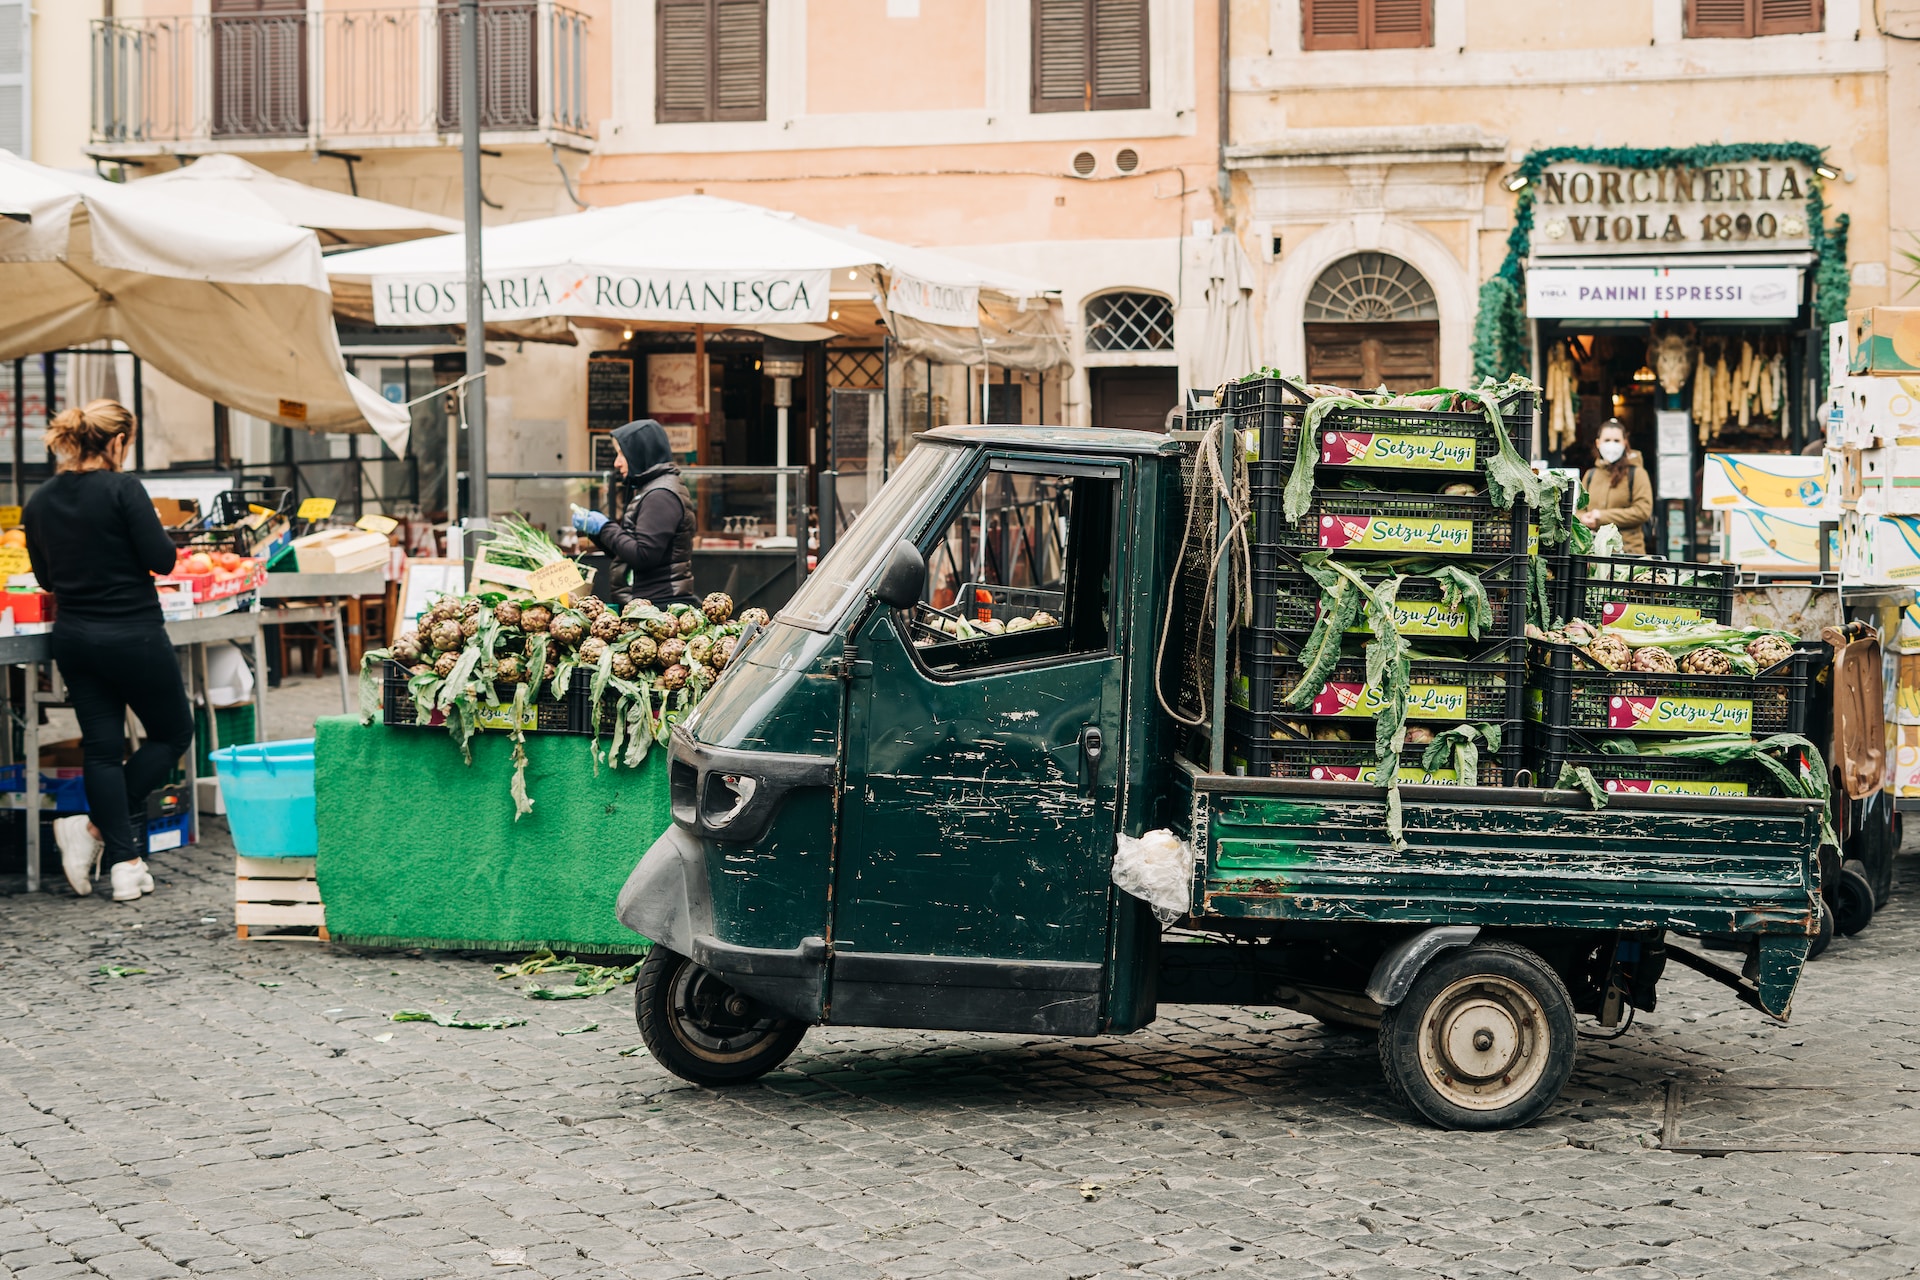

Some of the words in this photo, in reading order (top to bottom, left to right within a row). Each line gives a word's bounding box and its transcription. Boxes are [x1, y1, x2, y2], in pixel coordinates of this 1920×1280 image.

[1543, 166, 1804, 205] NORCINERIA
[1567, 214, 1686, 242] VIOLA
[1699, 212, 1778, 241] 1890
[387, 276, 551, 314] HOSARIA
[595, 275, 811, 312] ROMANESCA
[1579, 285, 1646, 301] PANINI
[1655, 285, 1743, 301] ESPRESSI
[1374, 437, 1428, 460] Setzu
[1429, 440, 1471, 463] Luigi
[1372, 520, 1425, 542] Setzu
[1427, 523, 1468, 545] Luigi
[1393, 606, 1422, 625] tzu
[1422, 605, 1465, 627] Luigi
[1421, 689, 1463, 710] Luigi
[1658, 701, 1709, 722] Setzu
[1709, 702, 1749, 724] Luigi
